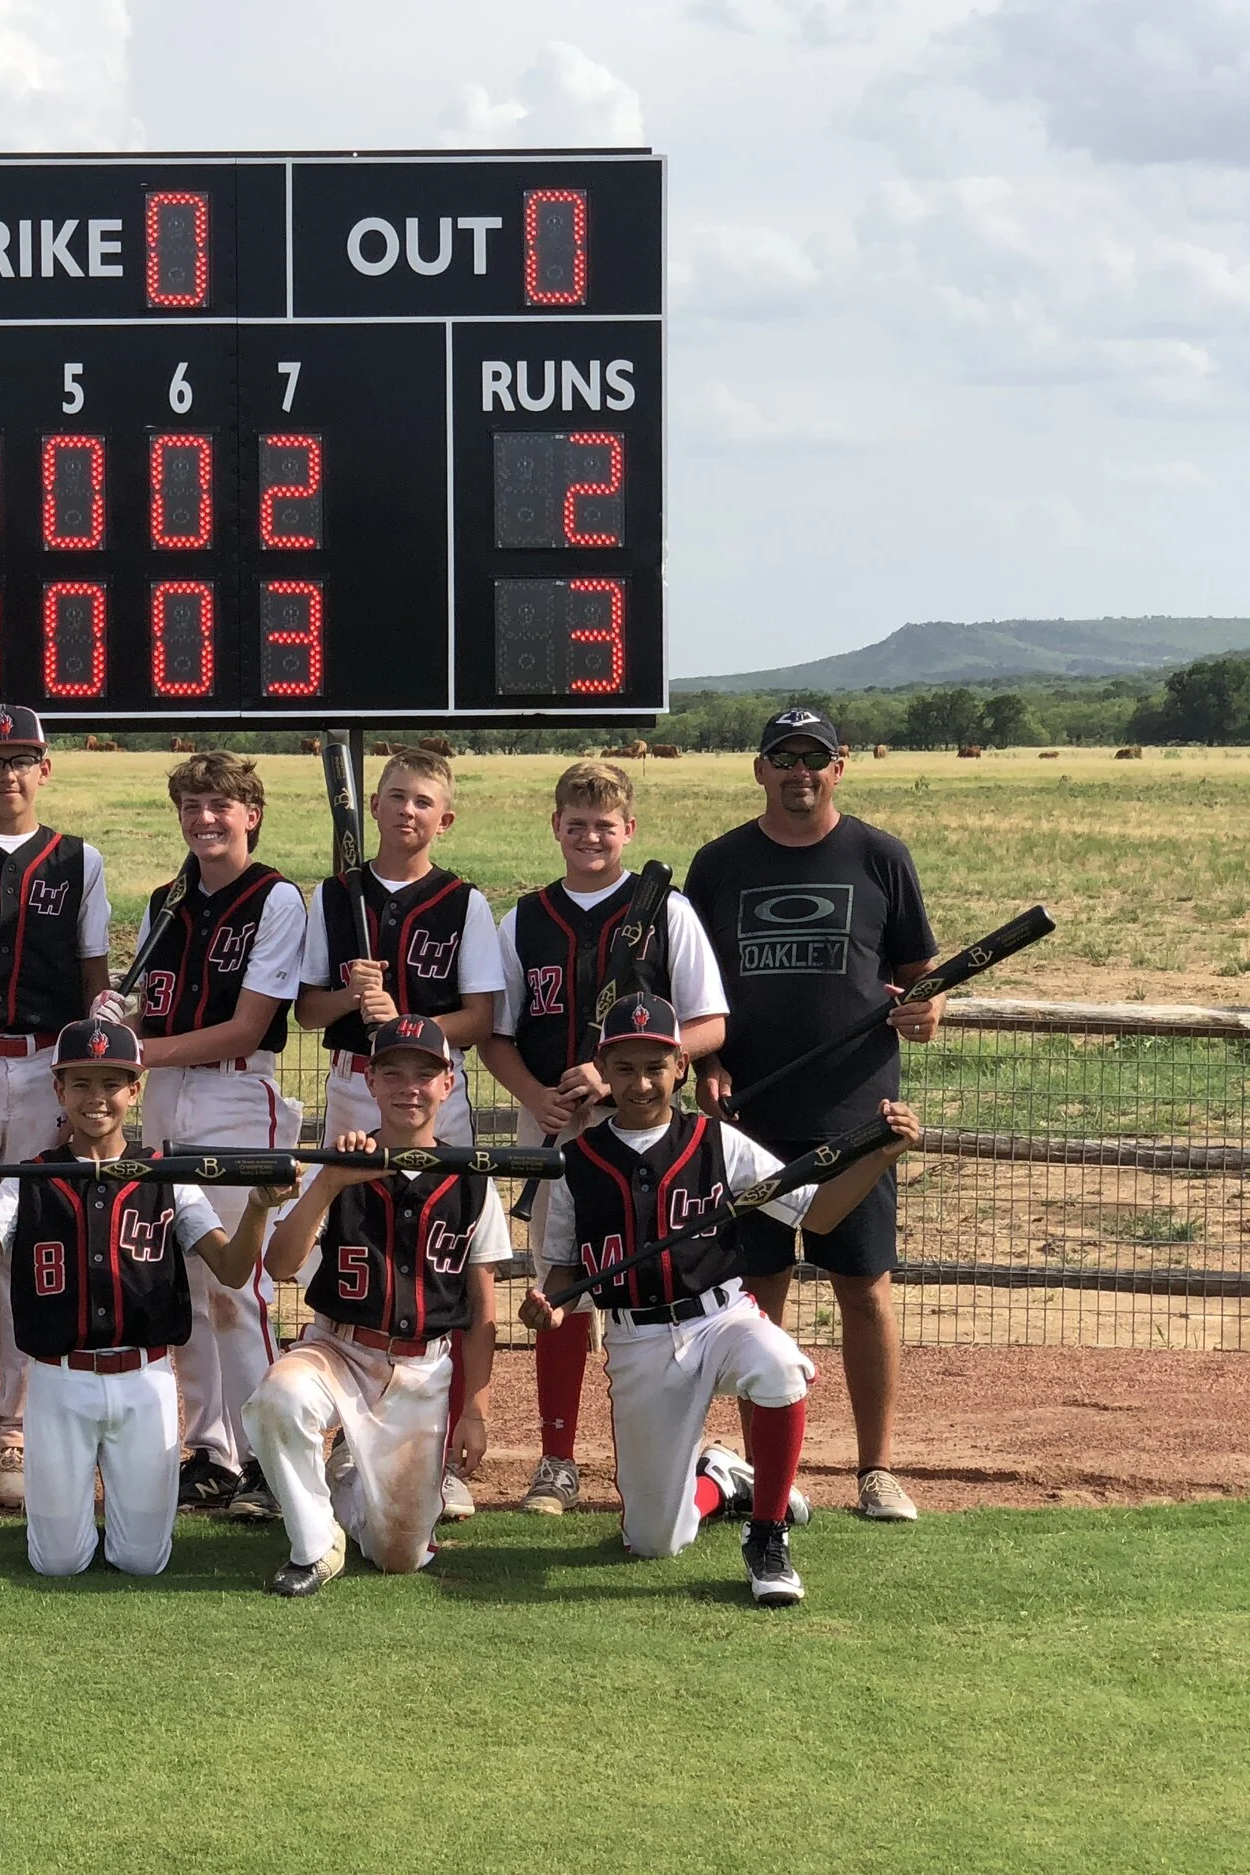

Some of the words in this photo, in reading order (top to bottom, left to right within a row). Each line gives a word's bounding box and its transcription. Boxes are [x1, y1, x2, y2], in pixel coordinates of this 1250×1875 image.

[146, 193, 208, 305] 0
[347, 217, 502, 276] OUT
[525, 190, 585, 303] 0
[62, 363, 85, 414] 5
[169, 362, 193, 413] 6
[278, 362, 302, 412] 7
[482, 360, 636, 411] RUNS
[43, 435, 104, 548] 0
[151, 434, 212, 547] 0
[260, 435, 321, 547] 2
[564, 433, 623, 545] 2
[44, 583, 105, 696] 0
[152, 582, 213, 695] 0
[268, 582, 322, 694] 3
[570, 580, 624, 692] 3
[744, 943, 842, 969] OAKLEY
[527, 965, 564, 1017] 32
[33, 1241, 66, 1296] 8
[338, 1245, 369, 1300] 5
